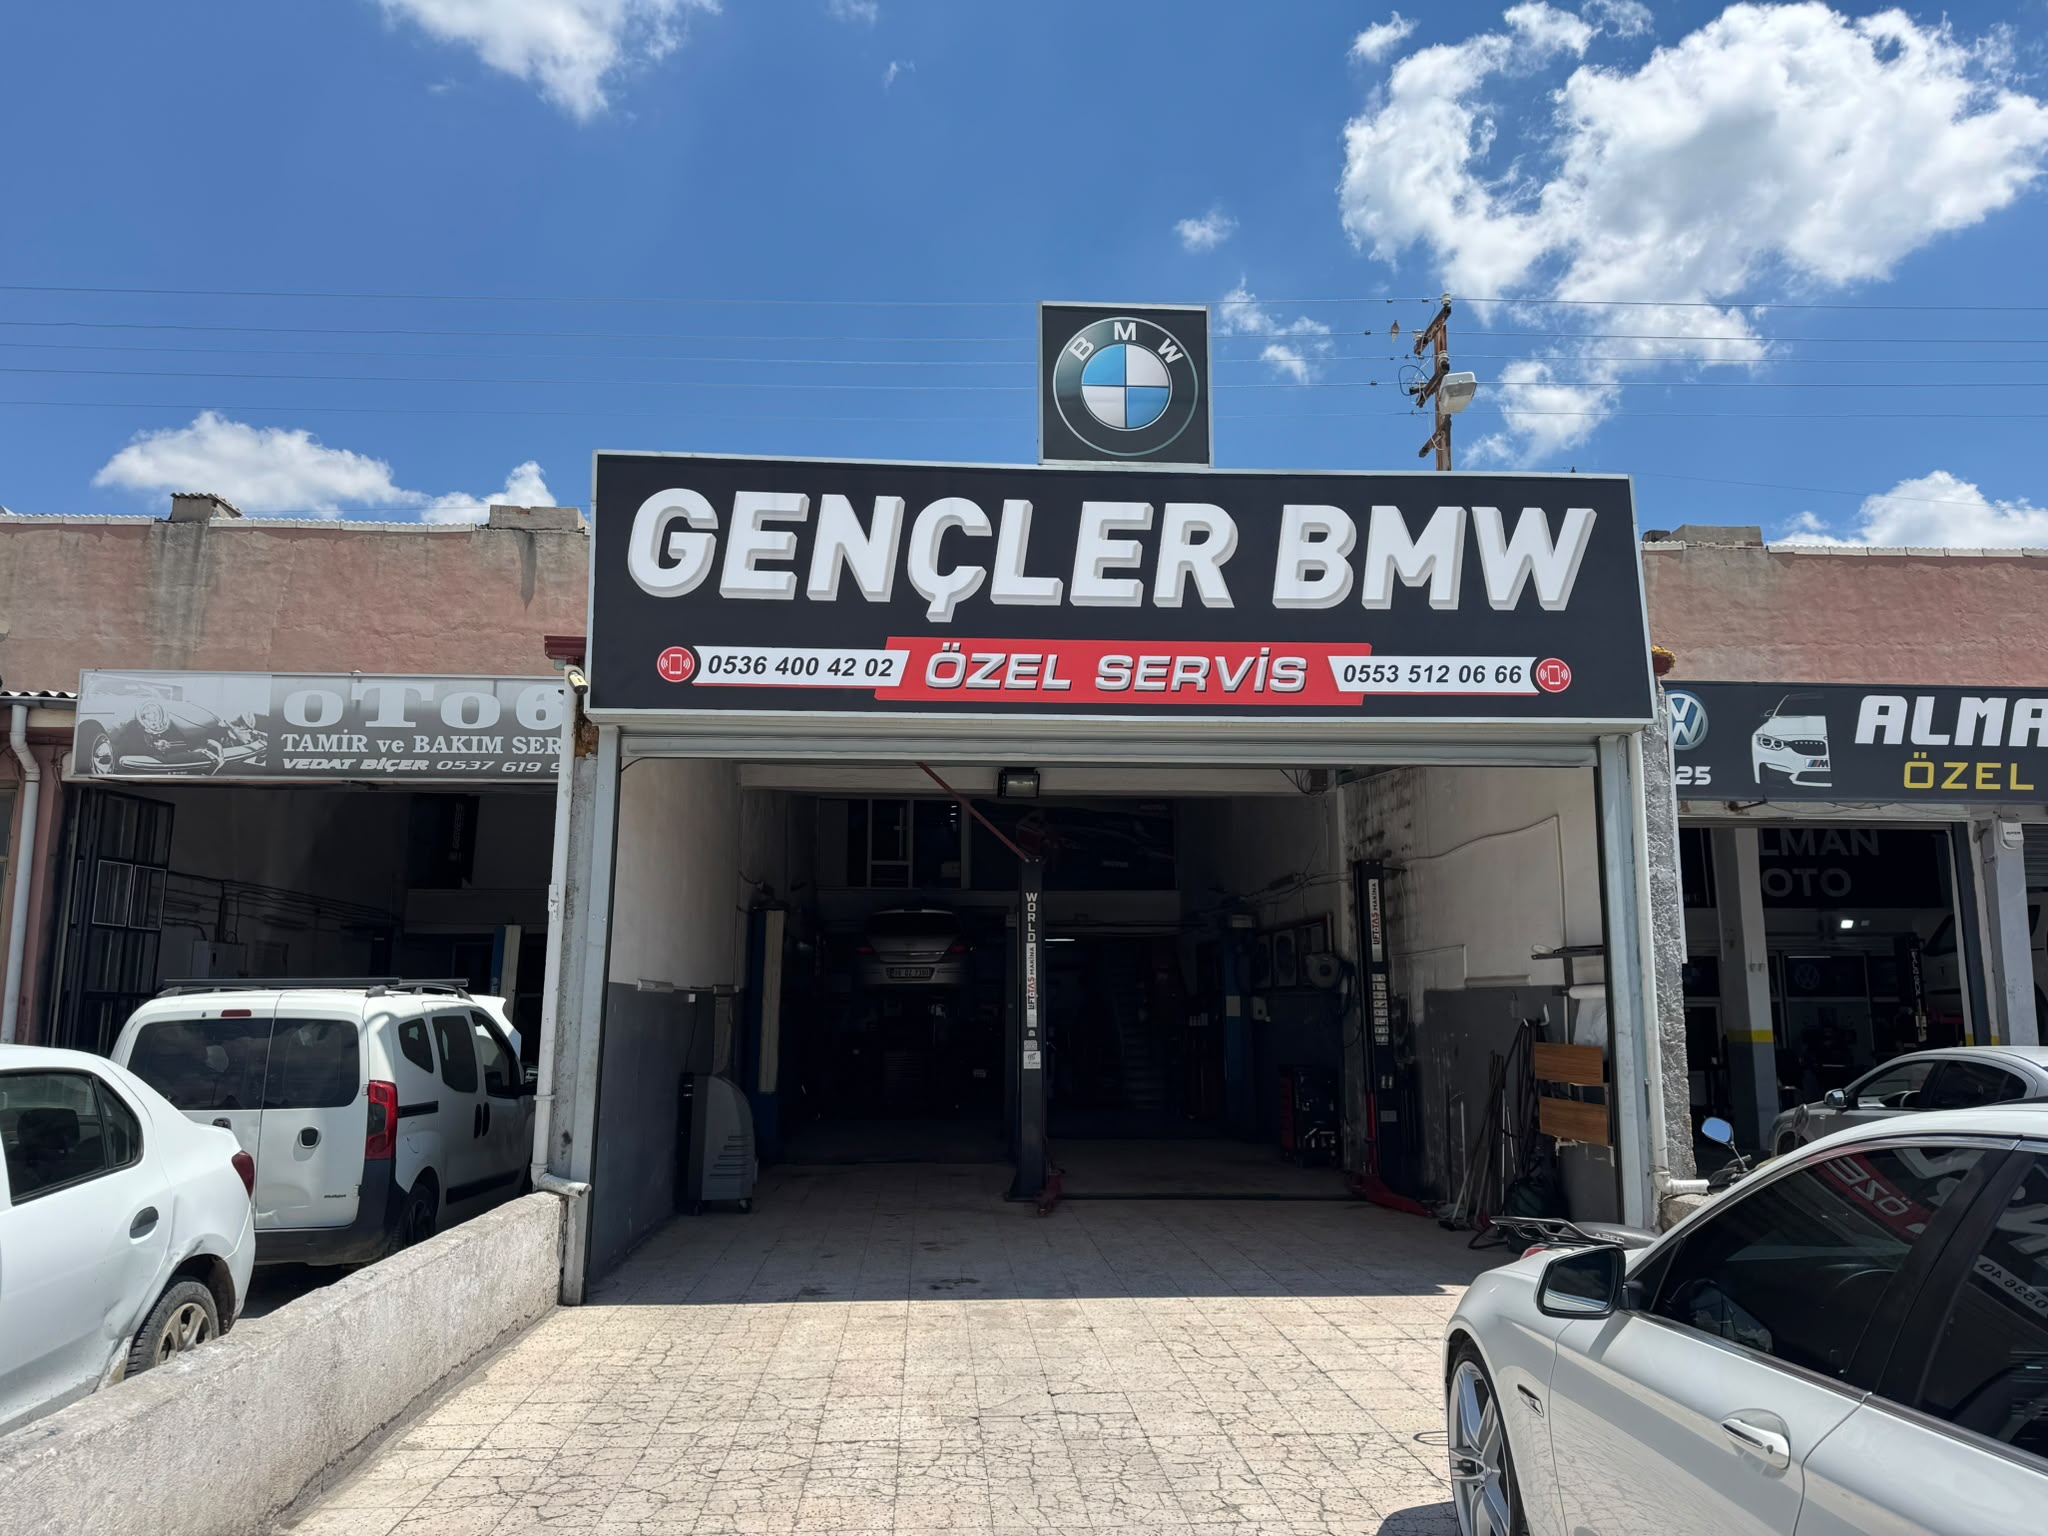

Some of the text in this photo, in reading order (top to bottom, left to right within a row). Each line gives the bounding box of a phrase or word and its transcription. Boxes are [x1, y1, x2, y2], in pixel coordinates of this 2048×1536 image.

[1068, 321, 1184, 364] BMW
[628, 487, 1597, 622] GENÇLER BMW
[707, 654, 894, 677] 0536 400 42 02
[924, 641, 1308, 693] ÖZEL SERVİS
[1343, 664, 1523, 683] 0553 512 06 66
[1854, 695, 2048, 748] ALMA
[280, 729, 561, 755] TAMİR ve BAKIM SER
[282, 758, 357, 770] VEDAT
[360, 757, 430, 773] BİÇER
[436, 760, 495, 771] 0537
[501, 761, 542, 773] 619
[1904, 752, 2035, 791] ÖZEL
[1761, 868, 1852, 897] OTO
[1025, 892, 1038, 942] WORLD
